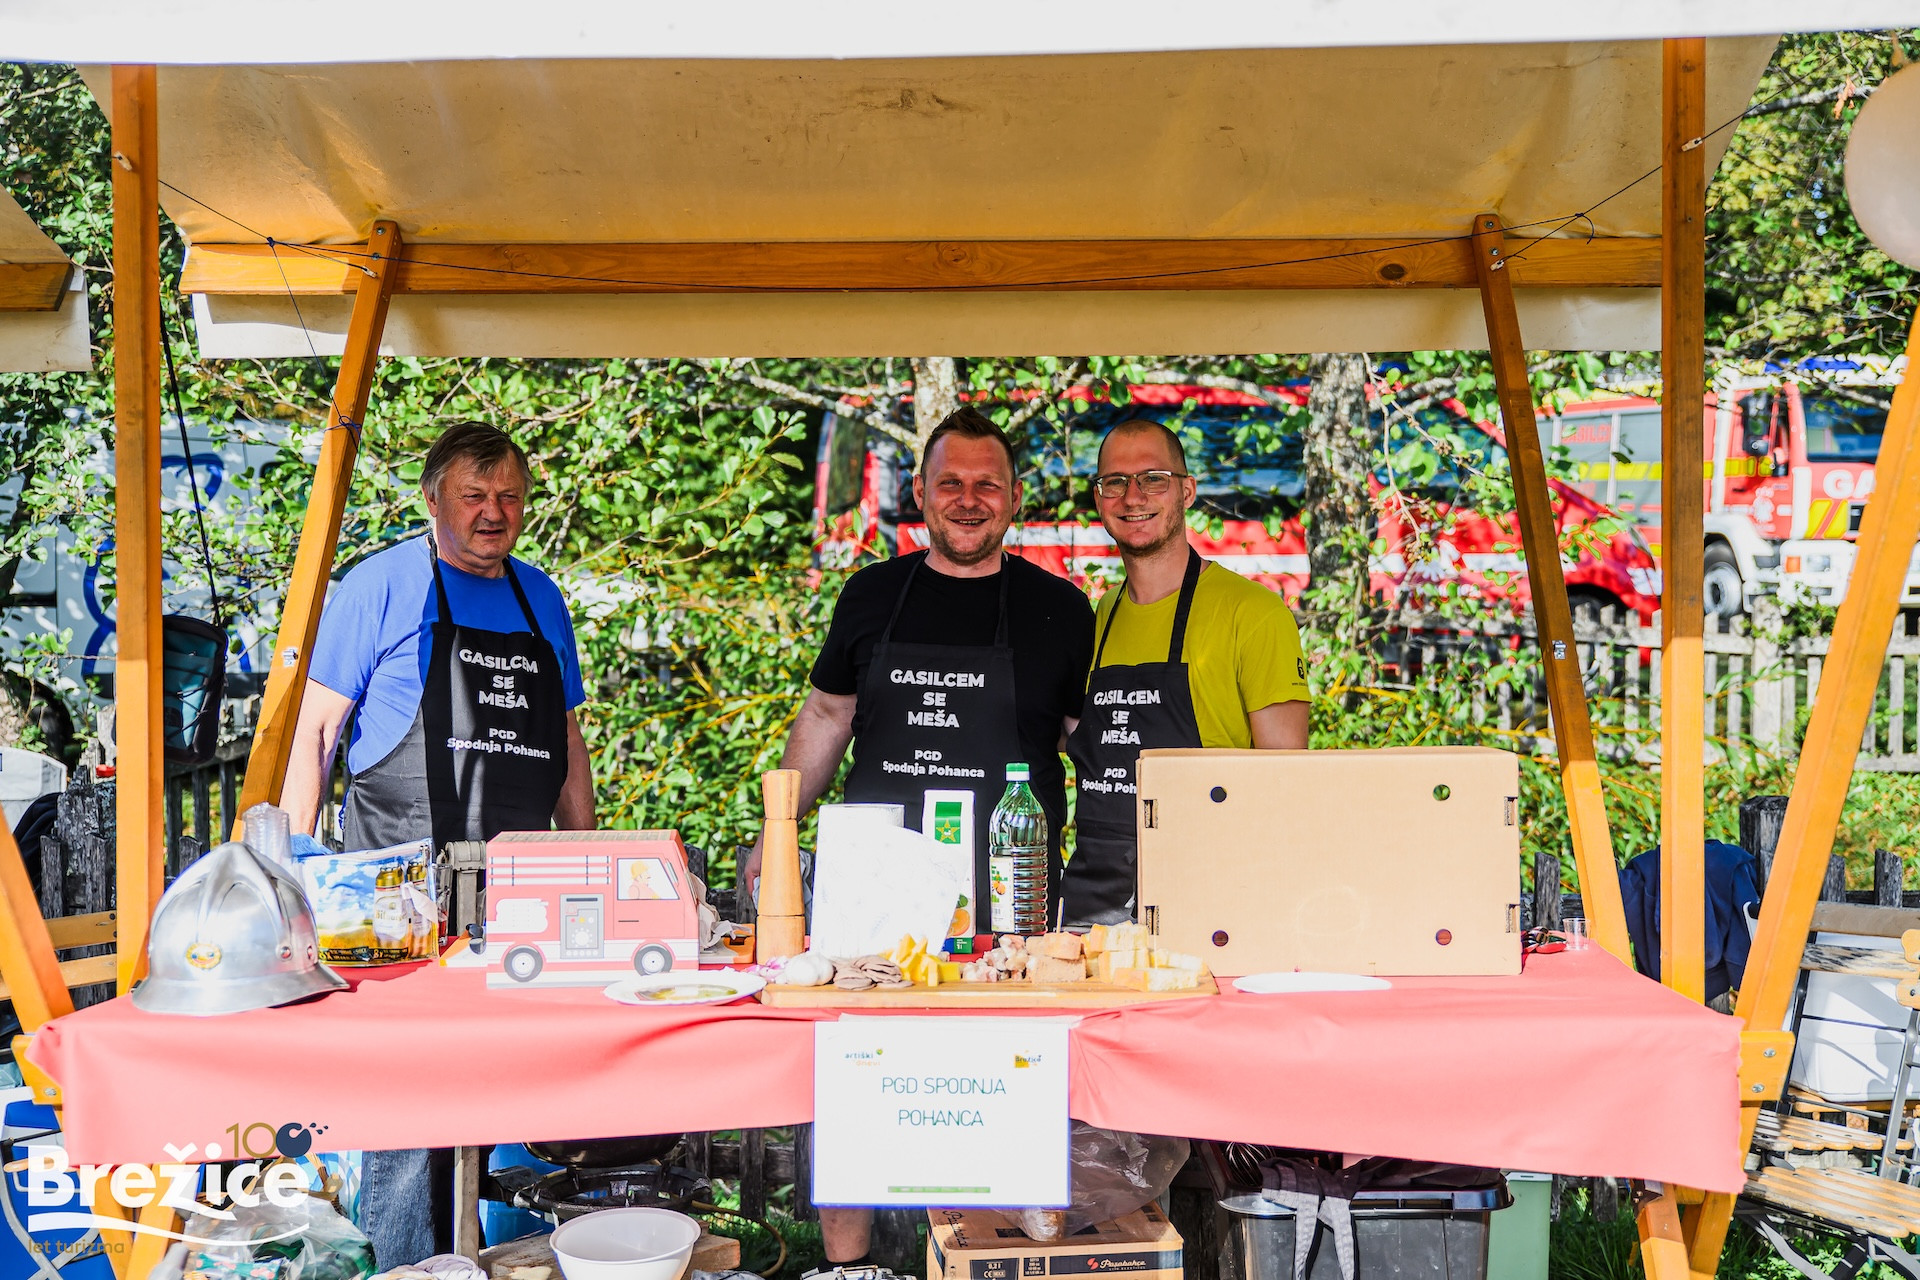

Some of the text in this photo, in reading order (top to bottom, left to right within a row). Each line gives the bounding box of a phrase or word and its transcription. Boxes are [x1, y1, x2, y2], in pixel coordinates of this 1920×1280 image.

[459, 648, 539, 673] GASILCEM
[492, 675, 515, 689] SE
[890, 669, 985, 687] GASILCEM
[479, 690, 529, 709] MEŠA
[922, 691, 947, 706] SE
[1094, 690, 1161, 705] GASILCEM
[907, 709, 960, 728] MEŠA
[1112, 710, 1130, 725] SE
[489, 728, 517, 740] PGD
[1101, 726, 1141, 745] MEŠA
[447, 737, 551, 759] Spodnja Pohanca
[914, 750, 942, 761] PGD
[882, 761, 985, 778] Spodnja Pohanca
[1104, 768, 1127, 778] PGD
[1082, 779, 1113, 794] Spodnja
[882, 1076, 1007, 1095] PGD SPODNJA
[898, 1109, 984, 1126] POHANCA
